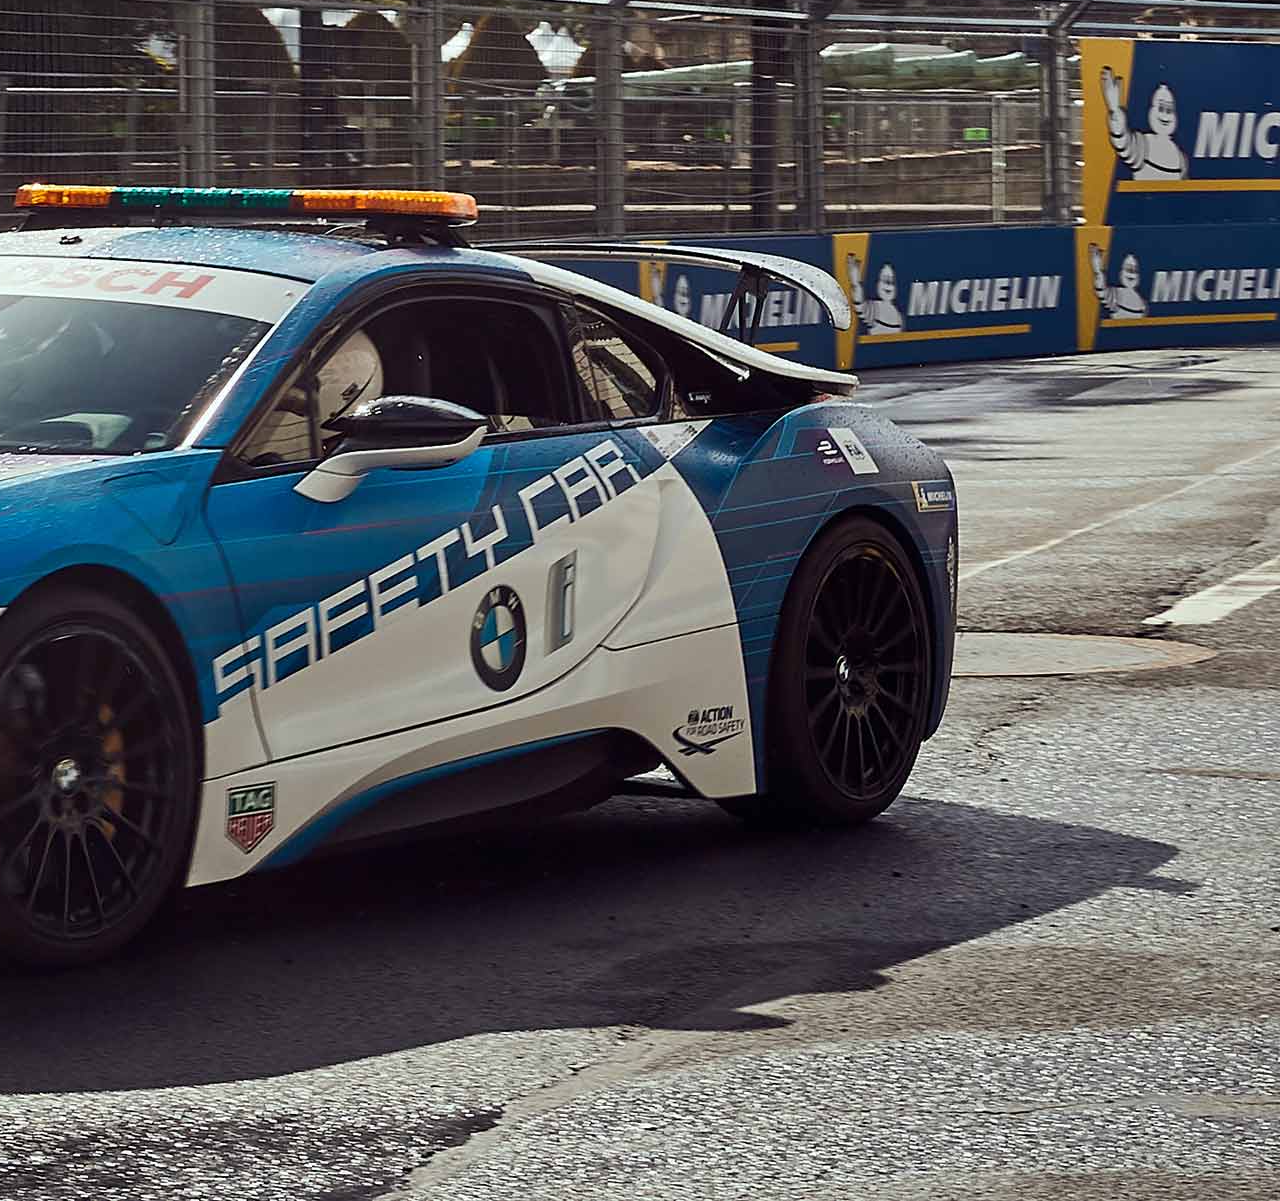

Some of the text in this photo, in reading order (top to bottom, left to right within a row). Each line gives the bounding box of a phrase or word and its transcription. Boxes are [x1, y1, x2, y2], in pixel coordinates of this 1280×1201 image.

[907, 274, 1062, 316] MICHELIN
[213, 438, 642, 697] SAFETY CAR
[701, 705, 733, 724] ACTION
[718, 718, 745, 735] SAFETY
[231, 788, 272, 813] TAG
